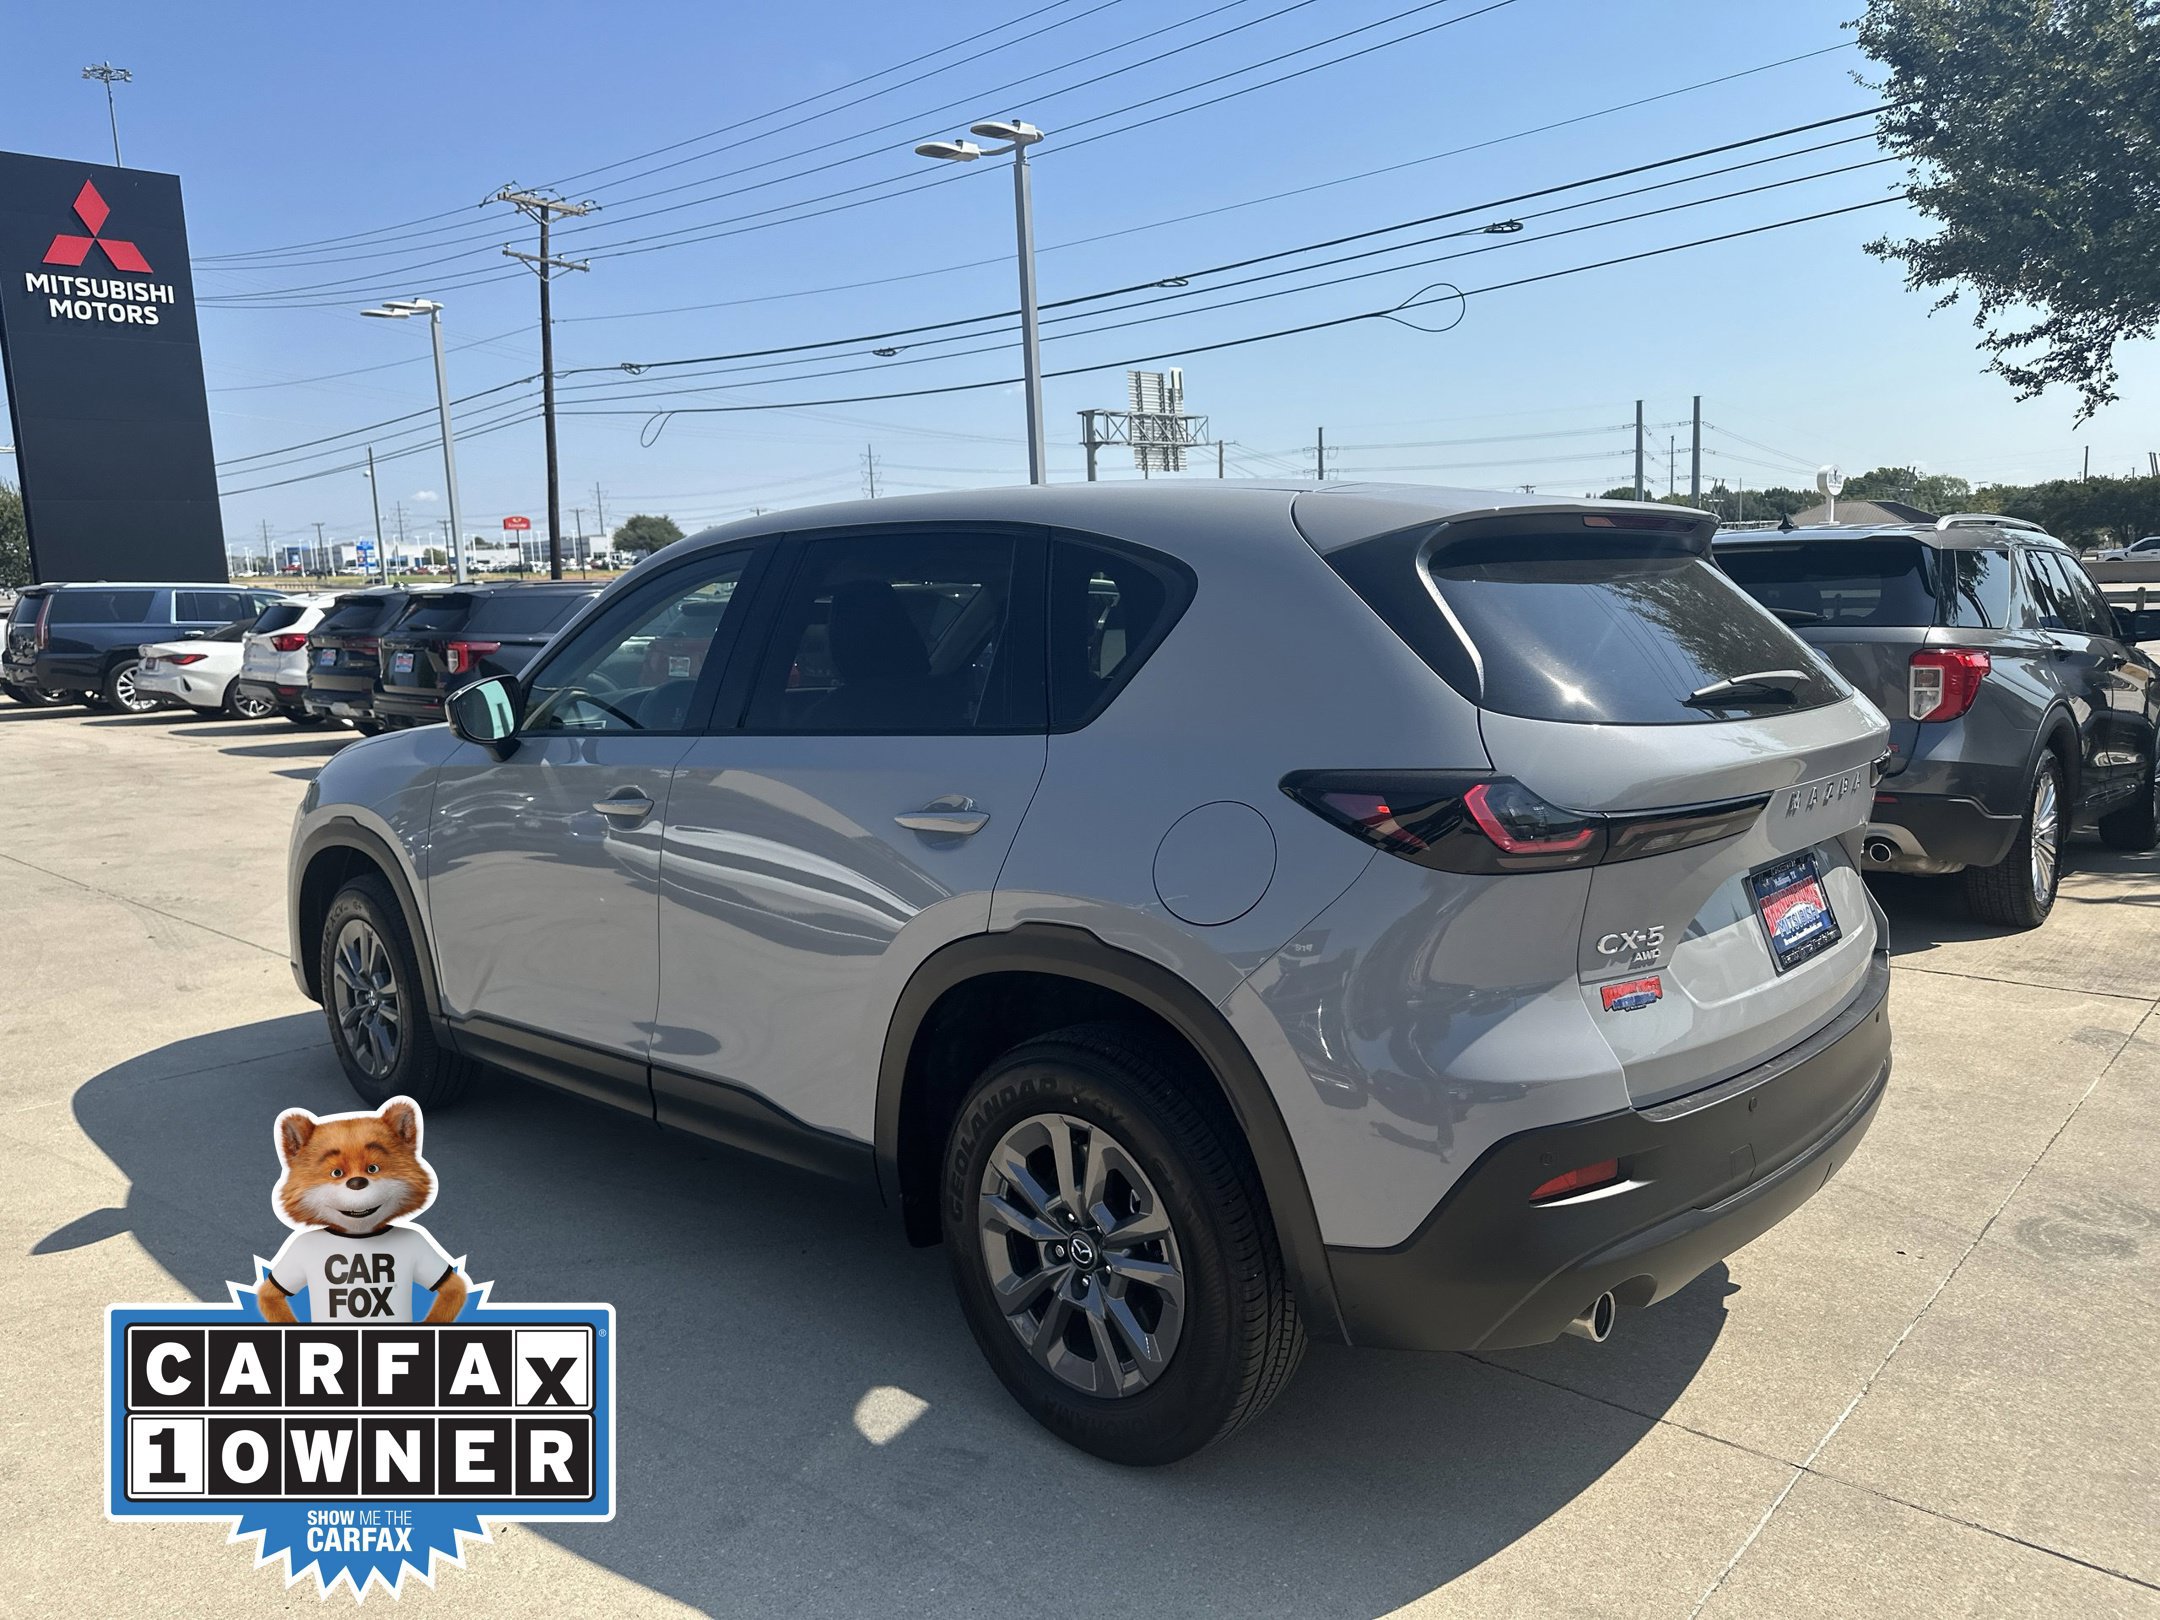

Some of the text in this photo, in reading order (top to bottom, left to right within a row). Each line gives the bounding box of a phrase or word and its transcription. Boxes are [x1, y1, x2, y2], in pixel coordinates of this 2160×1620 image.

[25, 272, 175, 304] MITSUBISHI
[49, 298, 159, 325] MOTORS
[1786, 771, 1861, 813] MAZDA
[1597, 925, 1665, 954] CX-5
[1633, 947, 1661, 962] AWD
[950, 1078, 1058, 1223] GEOLANDAR
